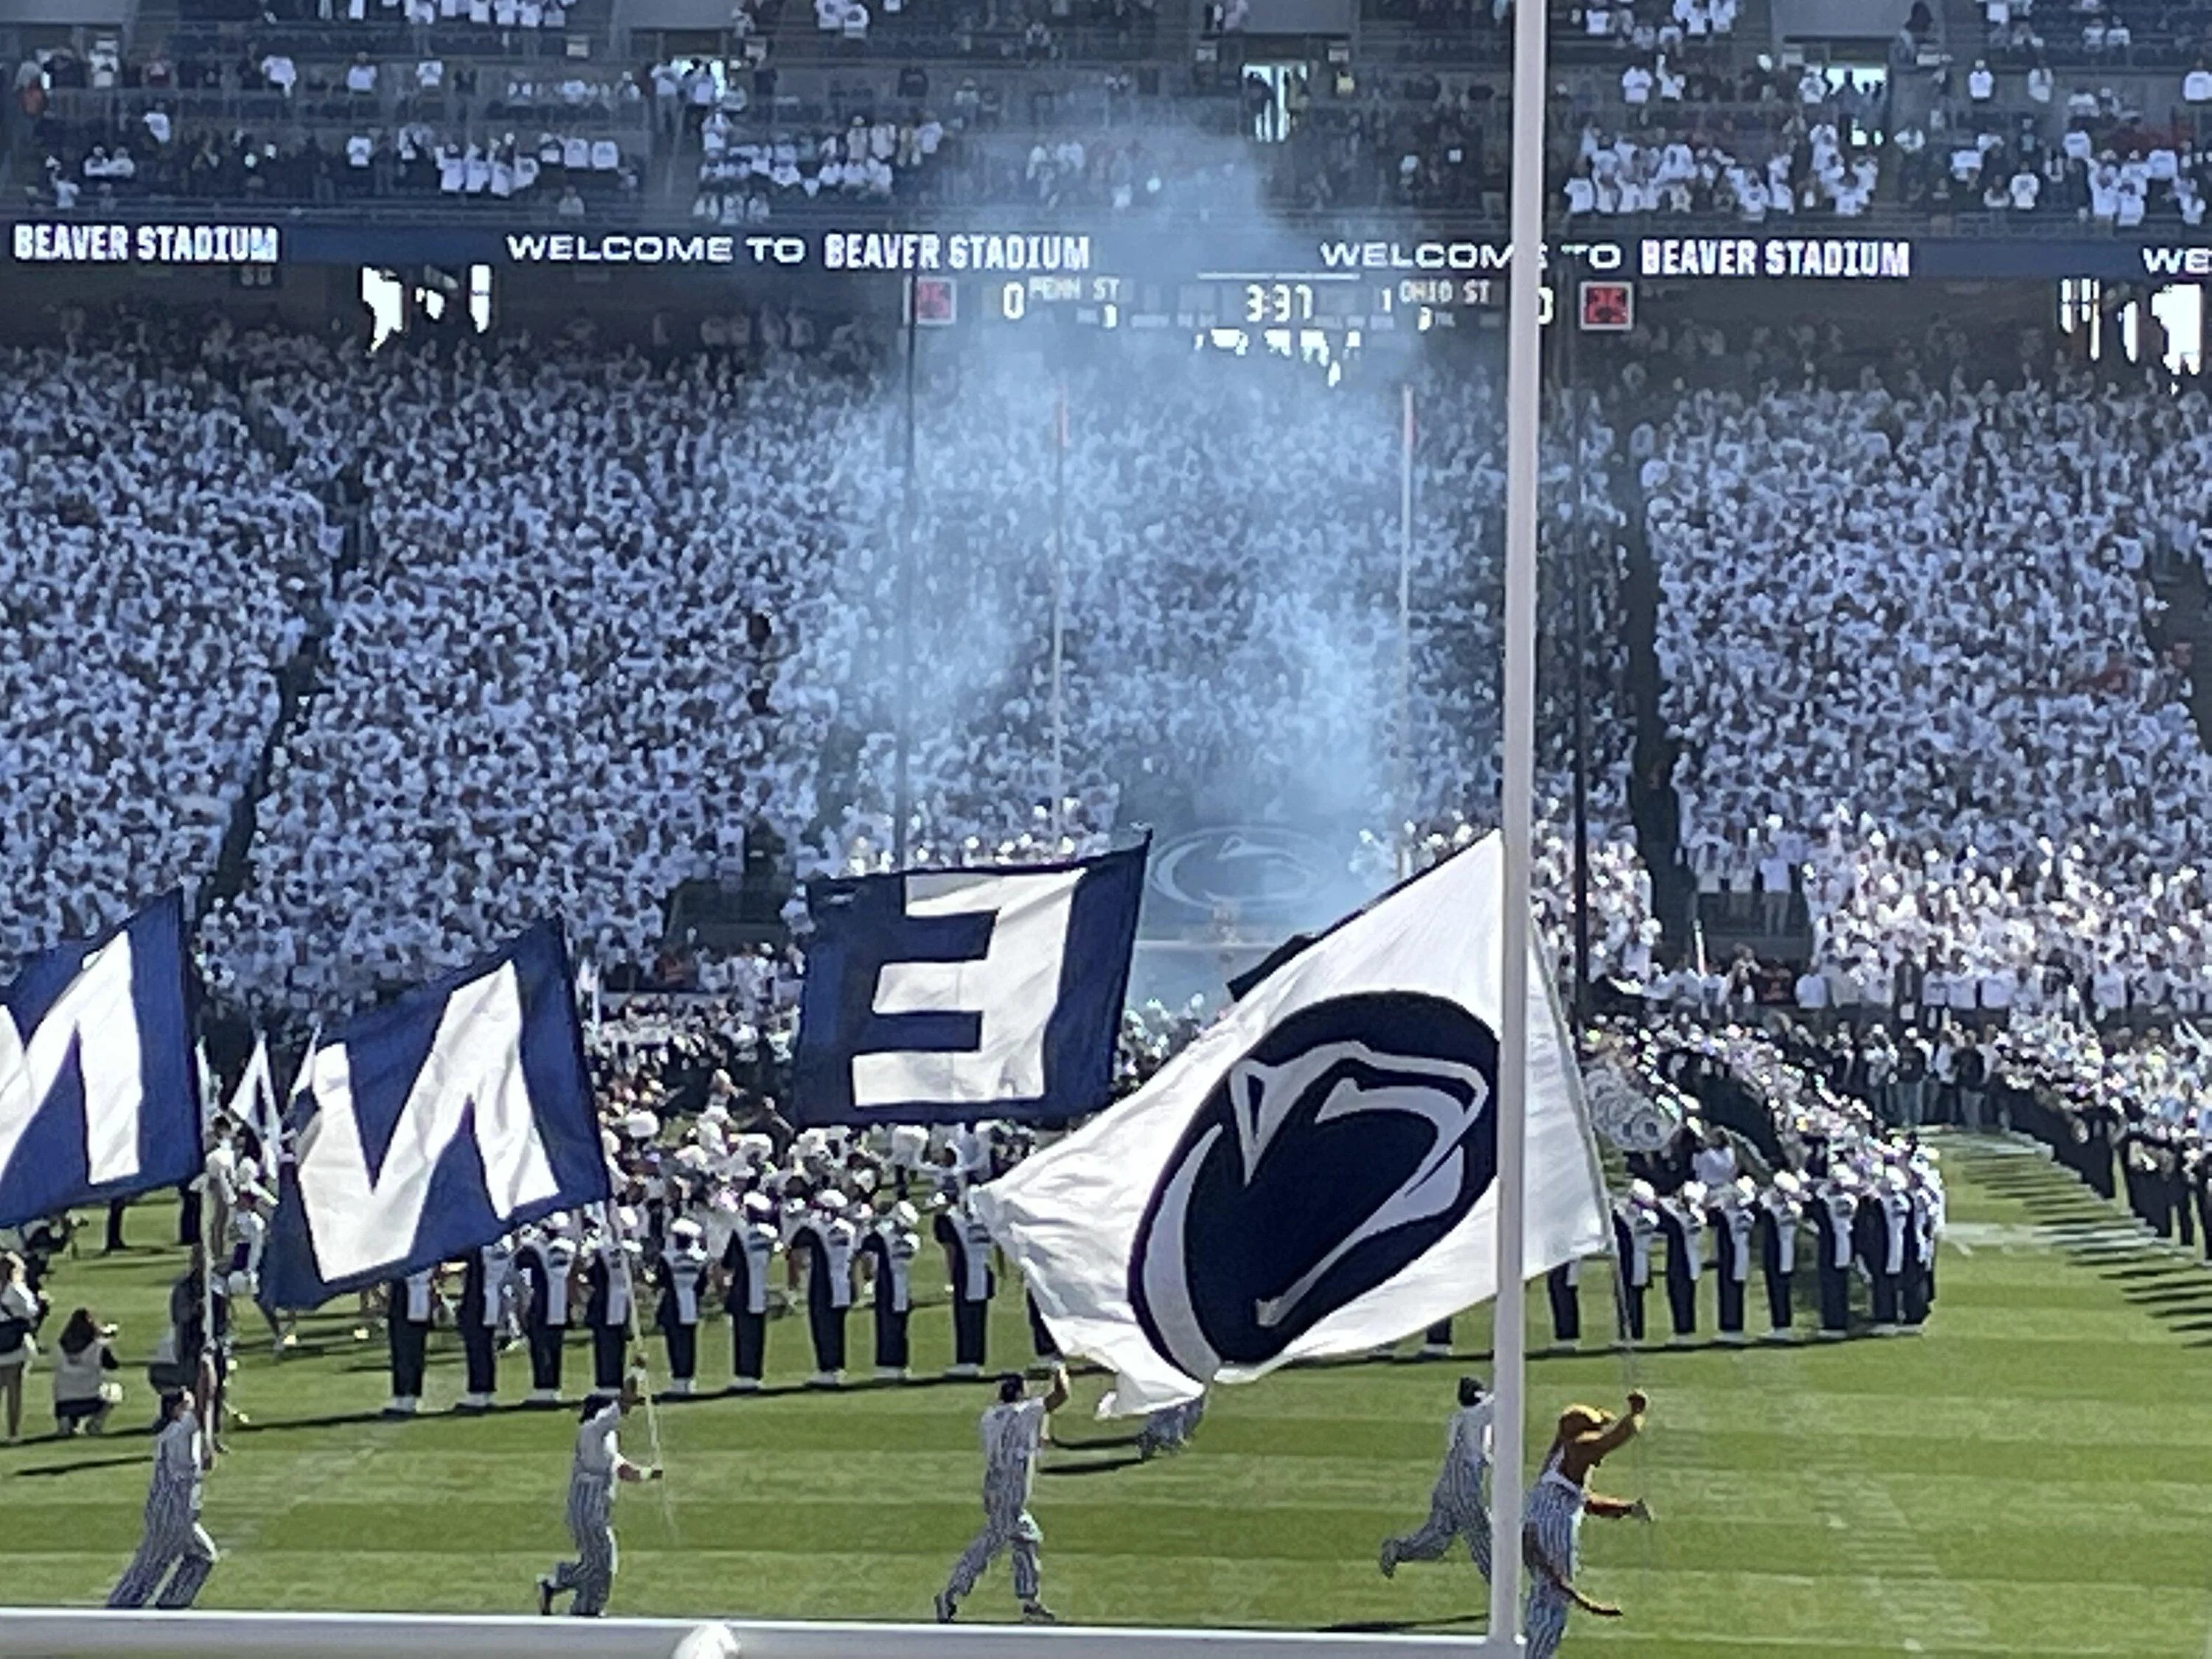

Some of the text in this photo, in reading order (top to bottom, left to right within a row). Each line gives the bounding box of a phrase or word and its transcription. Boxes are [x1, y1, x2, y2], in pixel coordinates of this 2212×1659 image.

[14, 223, 278, 263] BEAVER STADIUM
[507, 233, 1090, 271] WELCOME TO BEAVER STADIUM
[1320, 242, 1548, 270] WELCOM
[1641, 239, 1757, 276] BEAVER
[1765, 240, 1910, 277] STADIUM
[1003, 282, 1025, 319] 0
[1029, 276, 1120, 301] PENN ST
[1246, 284, 1313, 321] 3:37
[1399, 278, 1490, 305] OHIO ST
